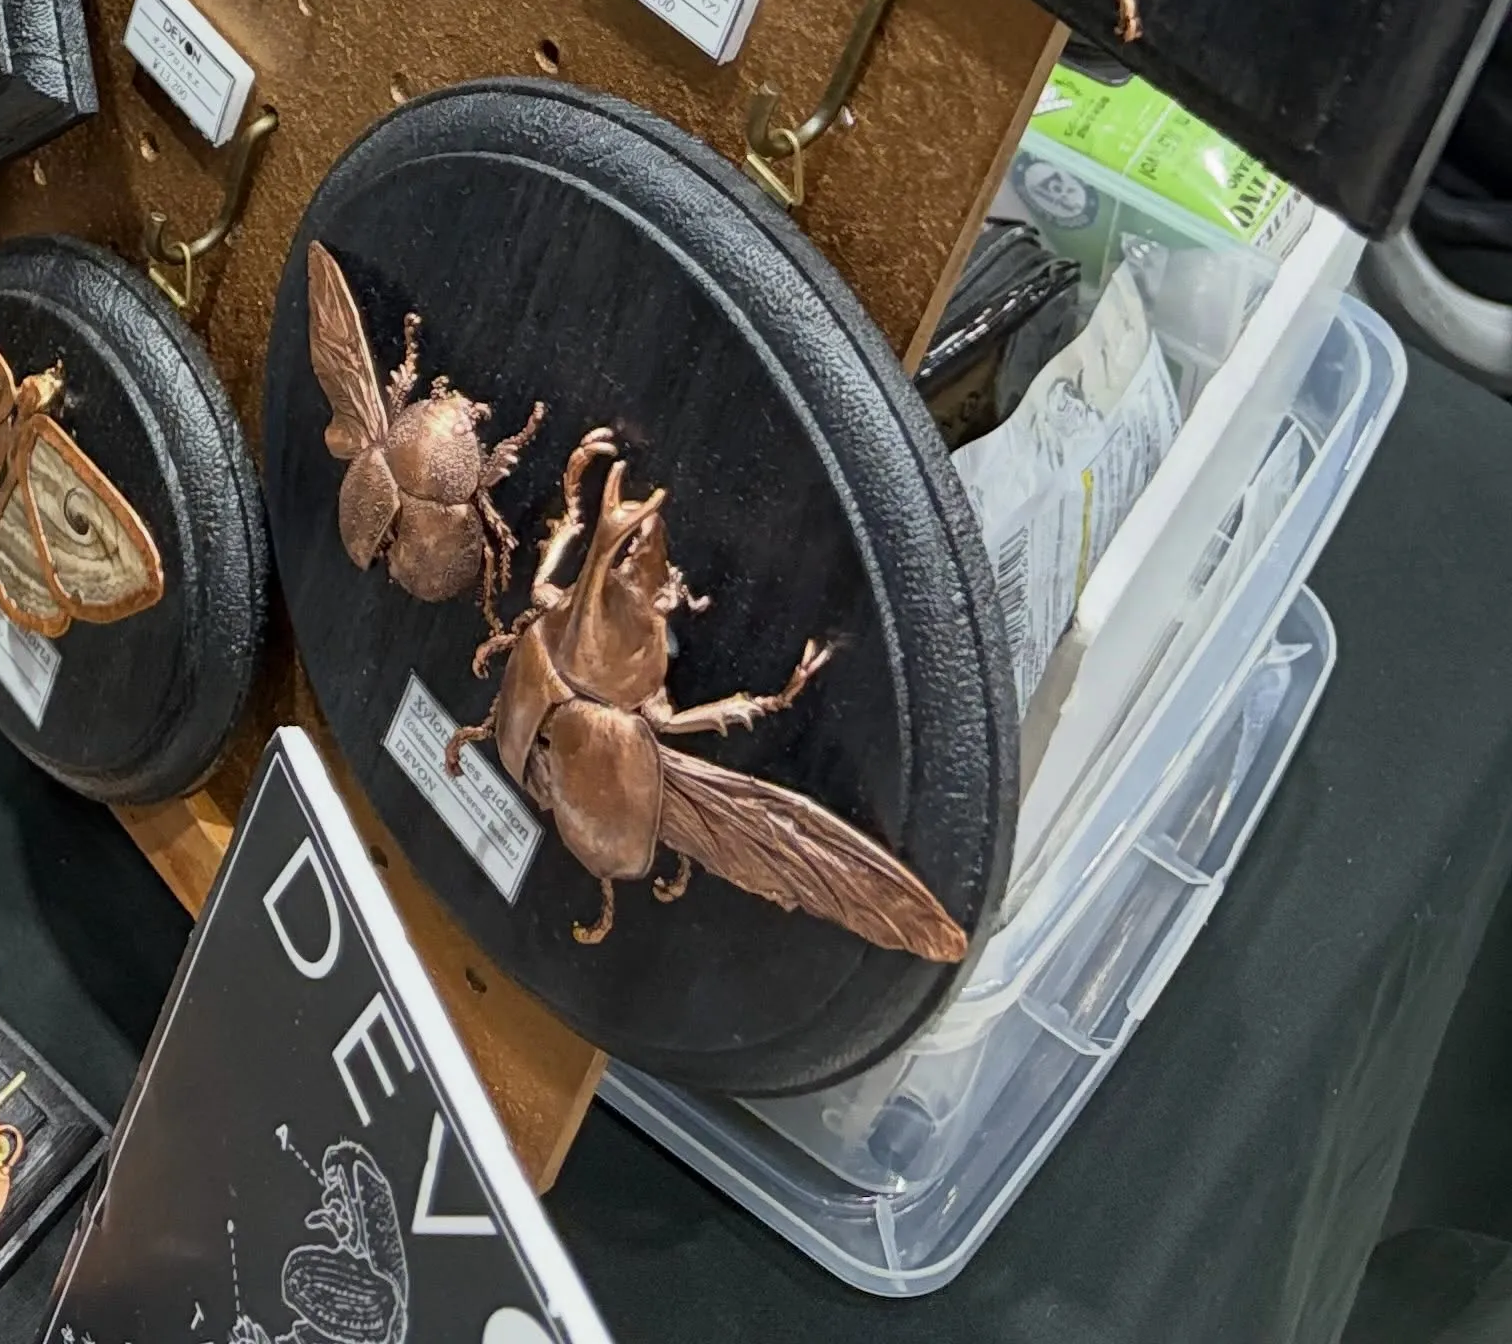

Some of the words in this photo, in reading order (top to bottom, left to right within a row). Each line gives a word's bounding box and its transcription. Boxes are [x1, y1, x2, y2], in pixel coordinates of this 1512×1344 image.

[162, 15, 202, 67] DEVON
[395, 735, 437, 795] DEVON
[480, 777, 531, 847] gideon
